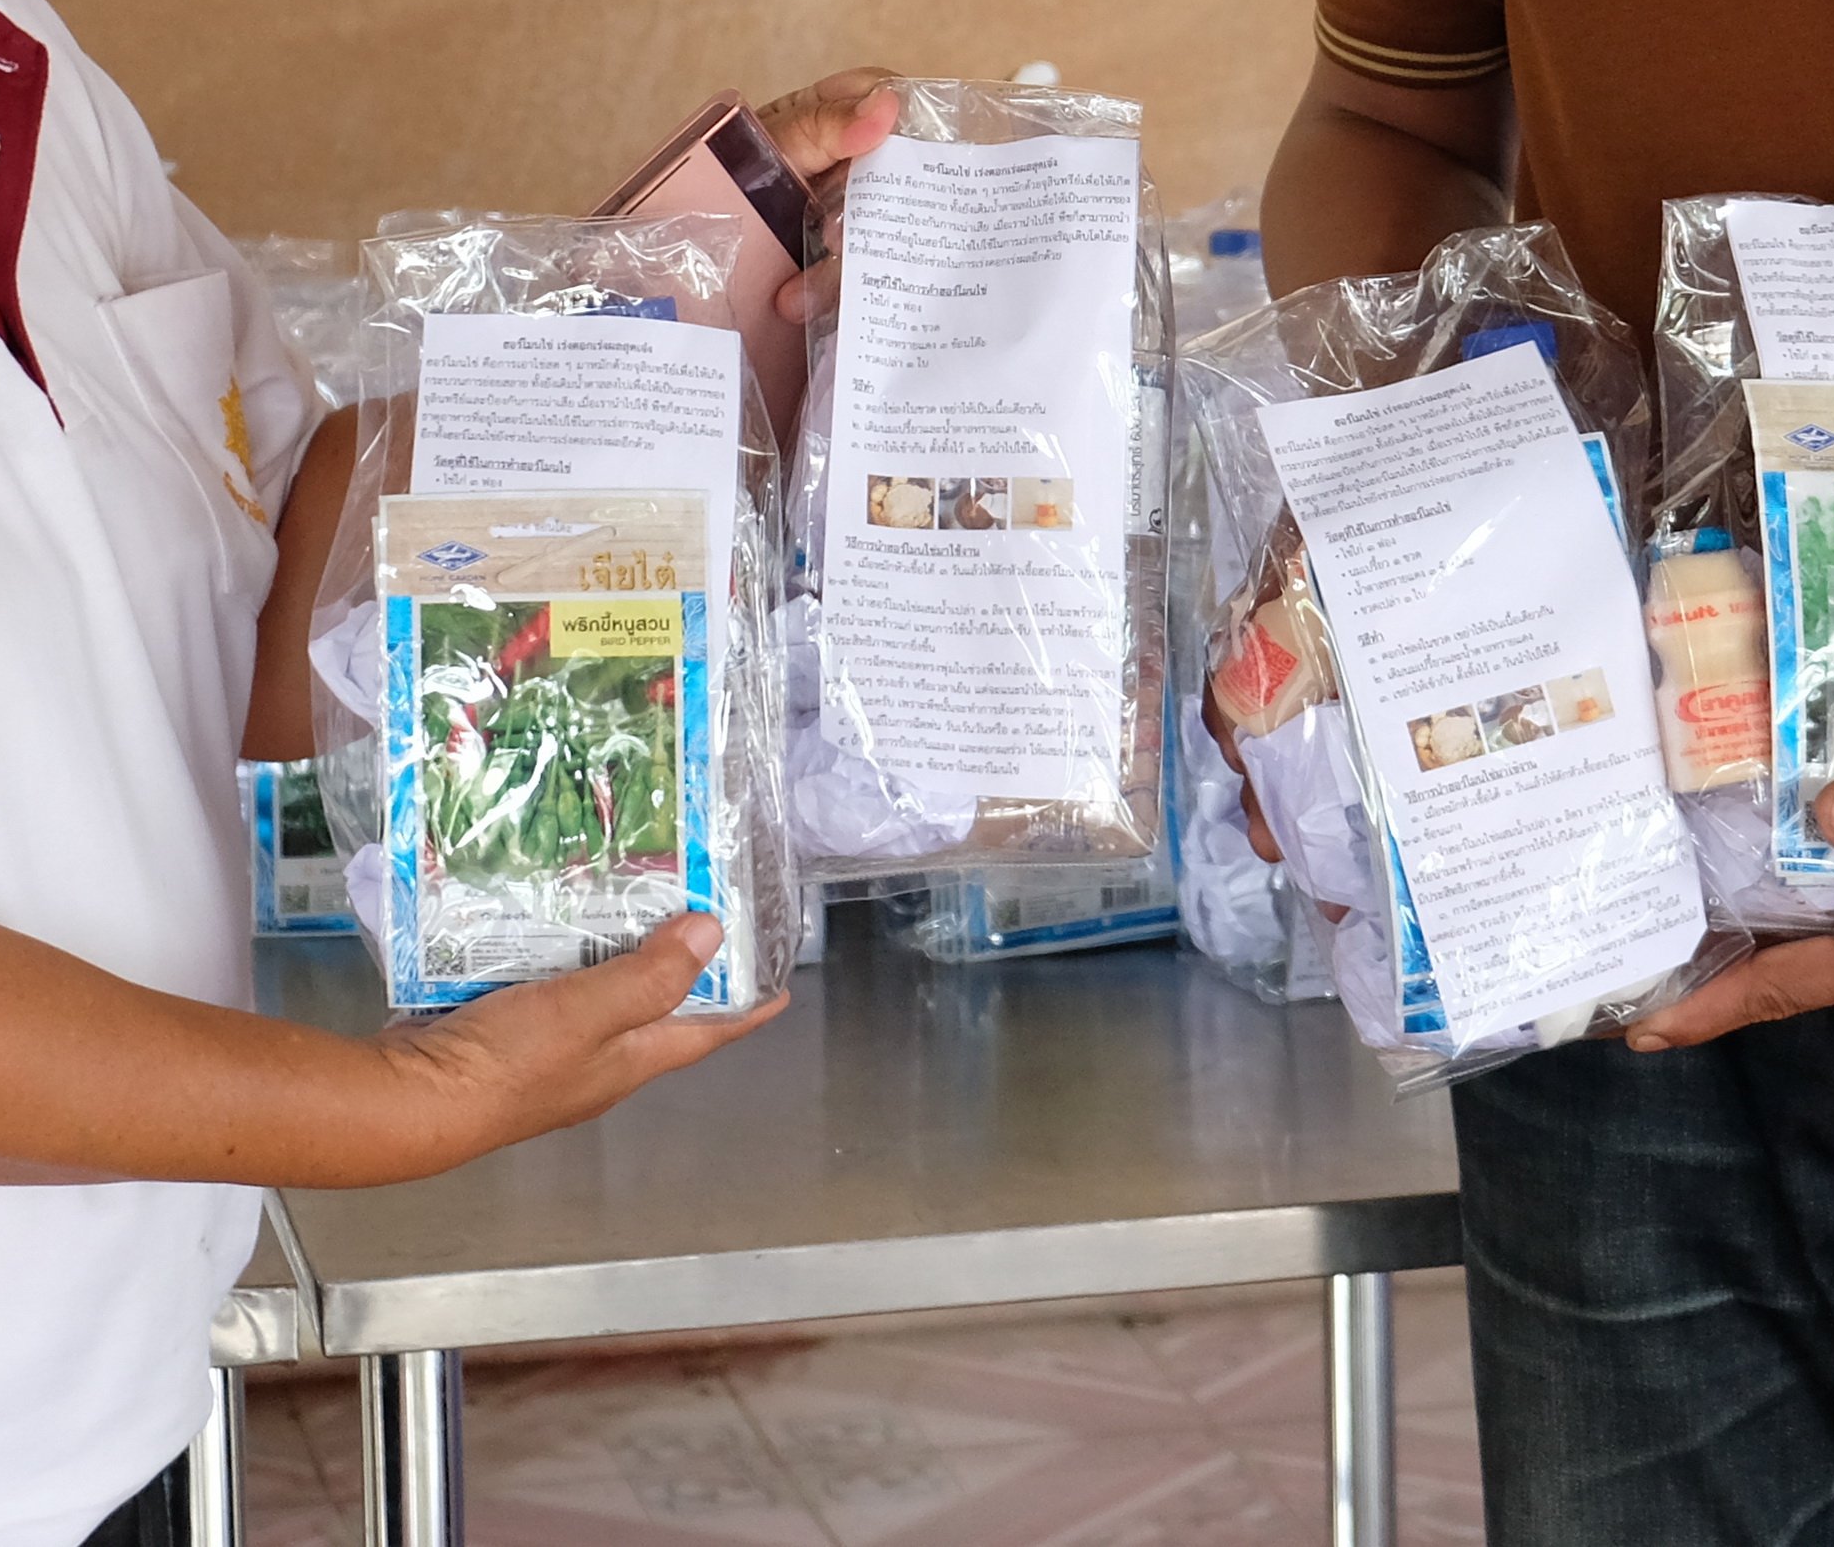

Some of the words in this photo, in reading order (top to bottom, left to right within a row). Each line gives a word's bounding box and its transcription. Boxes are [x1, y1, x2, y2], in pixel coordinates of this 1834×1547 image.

[562, 611, 670, 636] พริกขี้หนูสวน
[601, 637, 626, 646] BIRD
[630, 637, 670, 646] PEPPER
